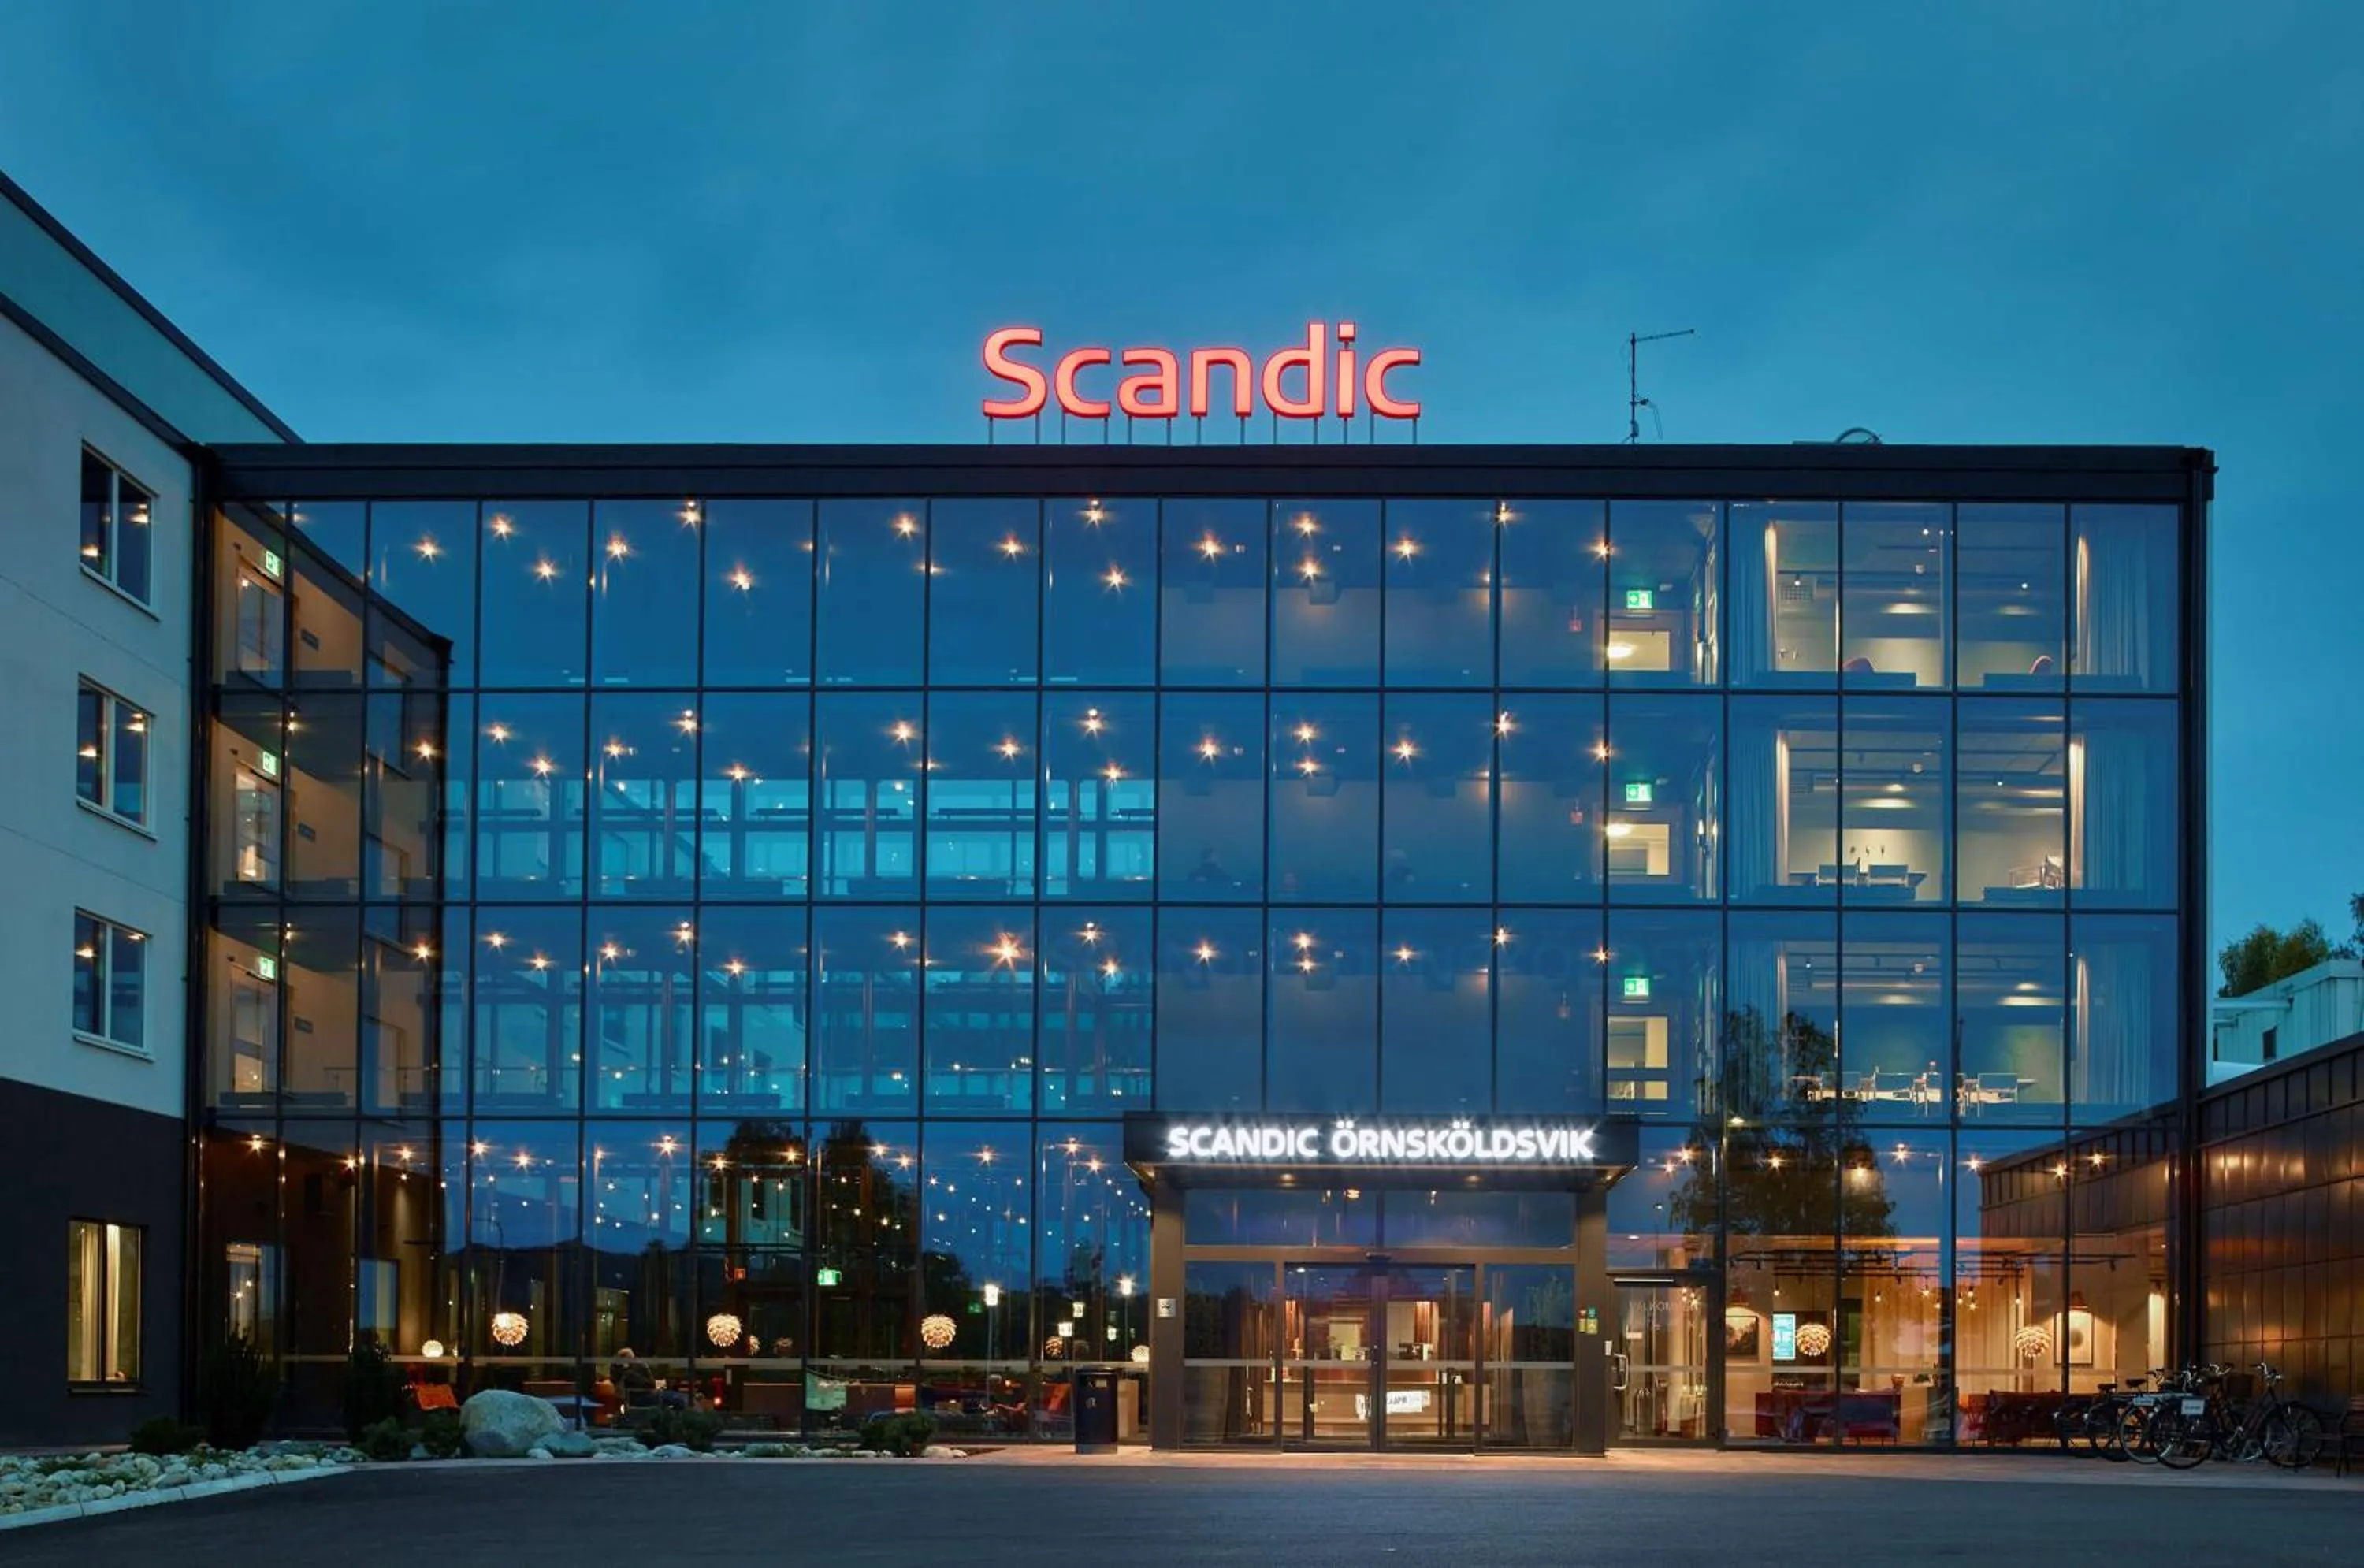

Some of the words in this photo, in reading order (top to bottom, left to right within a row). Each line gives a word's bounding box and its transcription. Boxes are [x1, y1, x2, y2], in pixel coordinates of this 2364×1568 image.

[983, 322, 1421, 418] Scandic
[1168, 1127, 1318, 1157] SCANDIC
[1331, 1120, 1593, 1158] ÖRNSKÖLDSVIK
